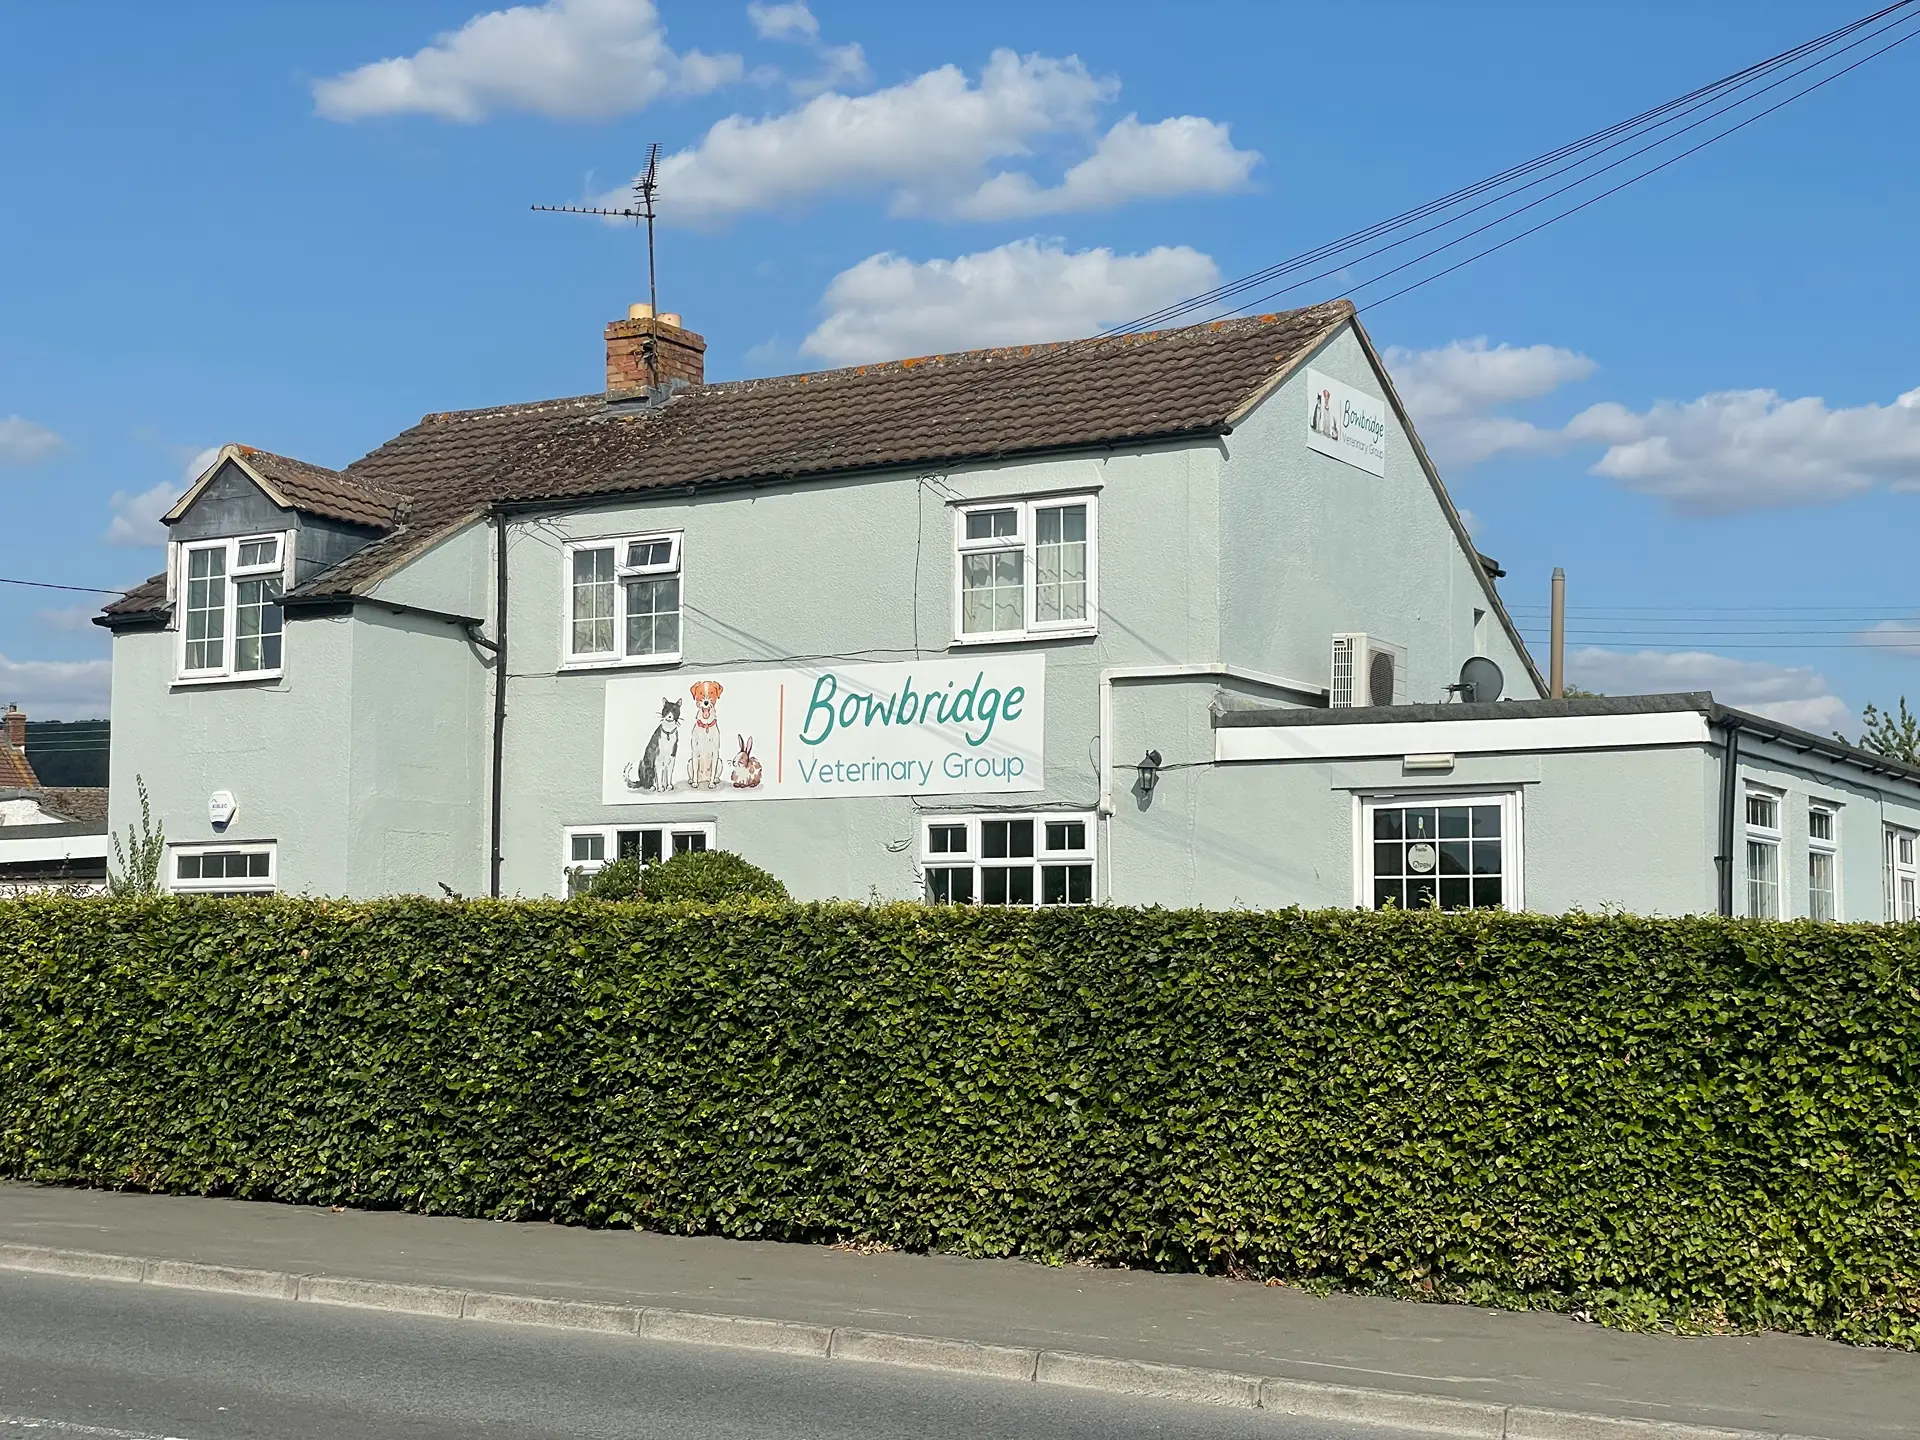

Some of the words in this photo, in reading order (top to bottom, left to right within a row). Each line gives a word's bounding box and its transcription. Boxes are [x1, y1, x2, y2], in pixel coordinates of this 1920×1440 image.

[1343, 400, 1384, 444] Bowbridge
[1343, 432, 1368, 454] Veterinary
[1369, 443, 1384, 460] Group
[799, 671, 1025, 746] Bowbridge
[798, 756, 933, 786] Veterinary
[943, 752, 1024, 783] Group
